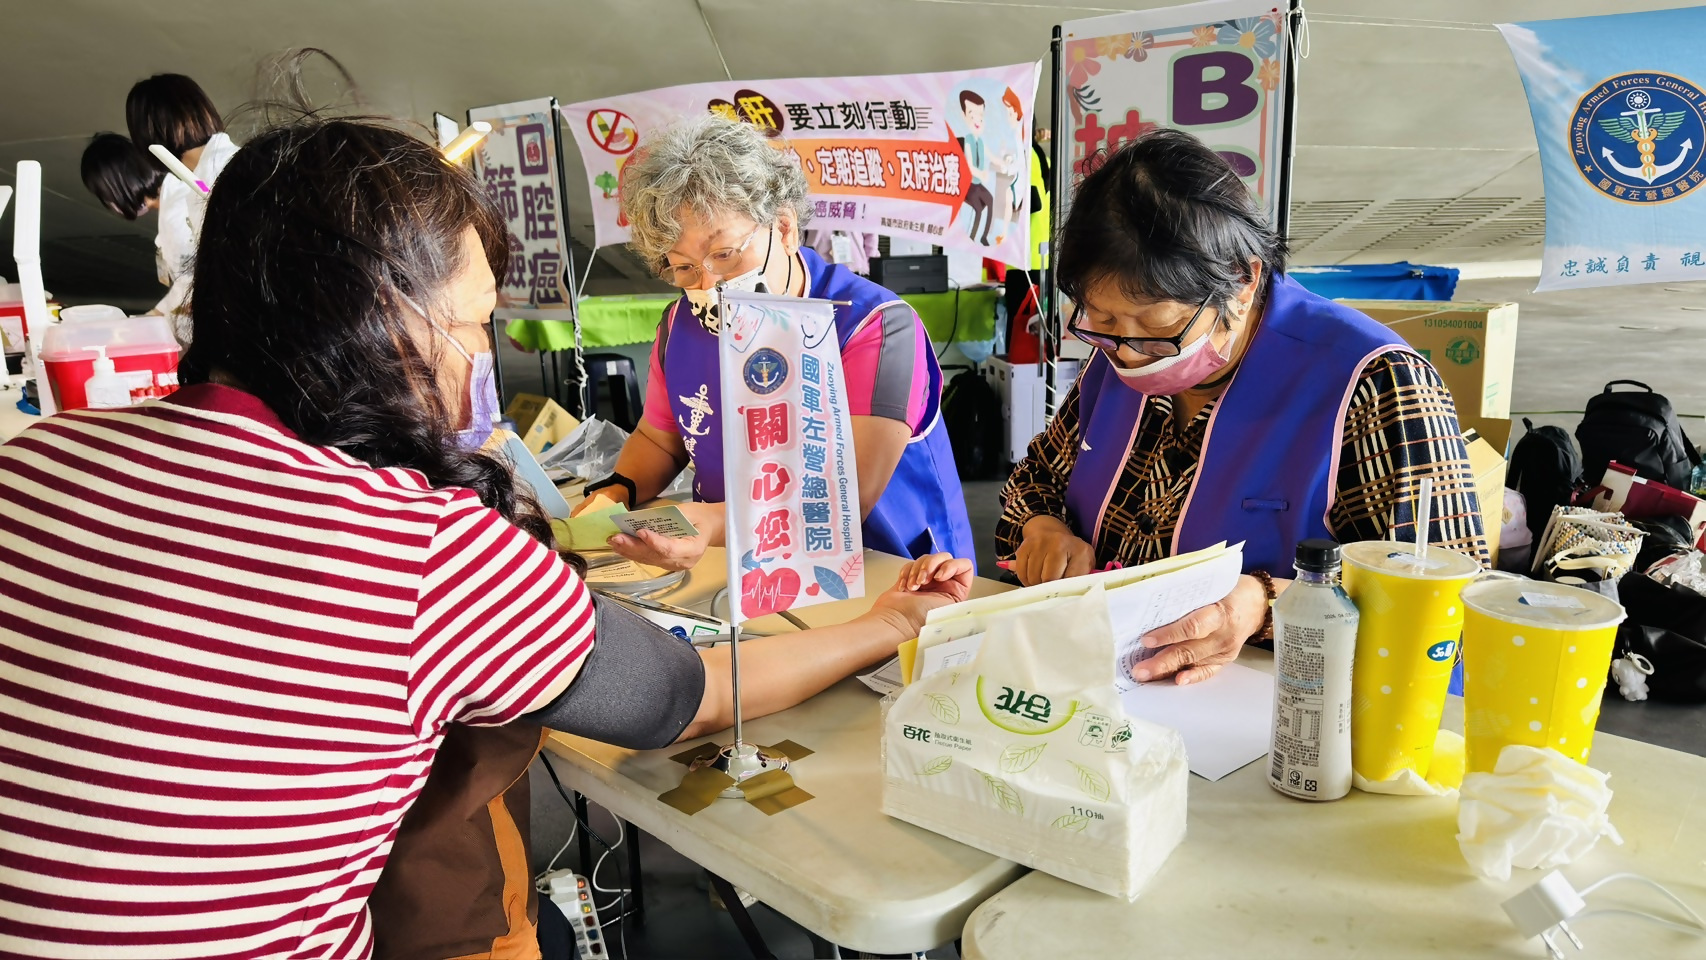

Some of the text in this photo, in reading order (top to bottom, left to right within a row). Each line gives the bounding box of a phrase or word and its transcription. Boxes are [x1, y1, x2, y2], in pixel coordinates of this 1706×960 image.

[785, 100, 917, 131] 要立刻行動
[1574, 76, 1700, 156] Zuoying Armed Forces General
[1598, 170, 1704, 200] 國軍左營總醫院
[516, 123, 563, 305] 口腔癌
[1560, 252, 1661, 277] 忠誠負責
[800, 353, 832, 552] 國軍左營總醫院
[826, 361, 853, 552] Zuoying Armed Forces General Hospital
[746, 403, 790, 557] 關心您
[994, 686, 1052, 723] 百花
[903, 724, 931, 743] 百花
[1070, 806, 1105, 821] 110抽
